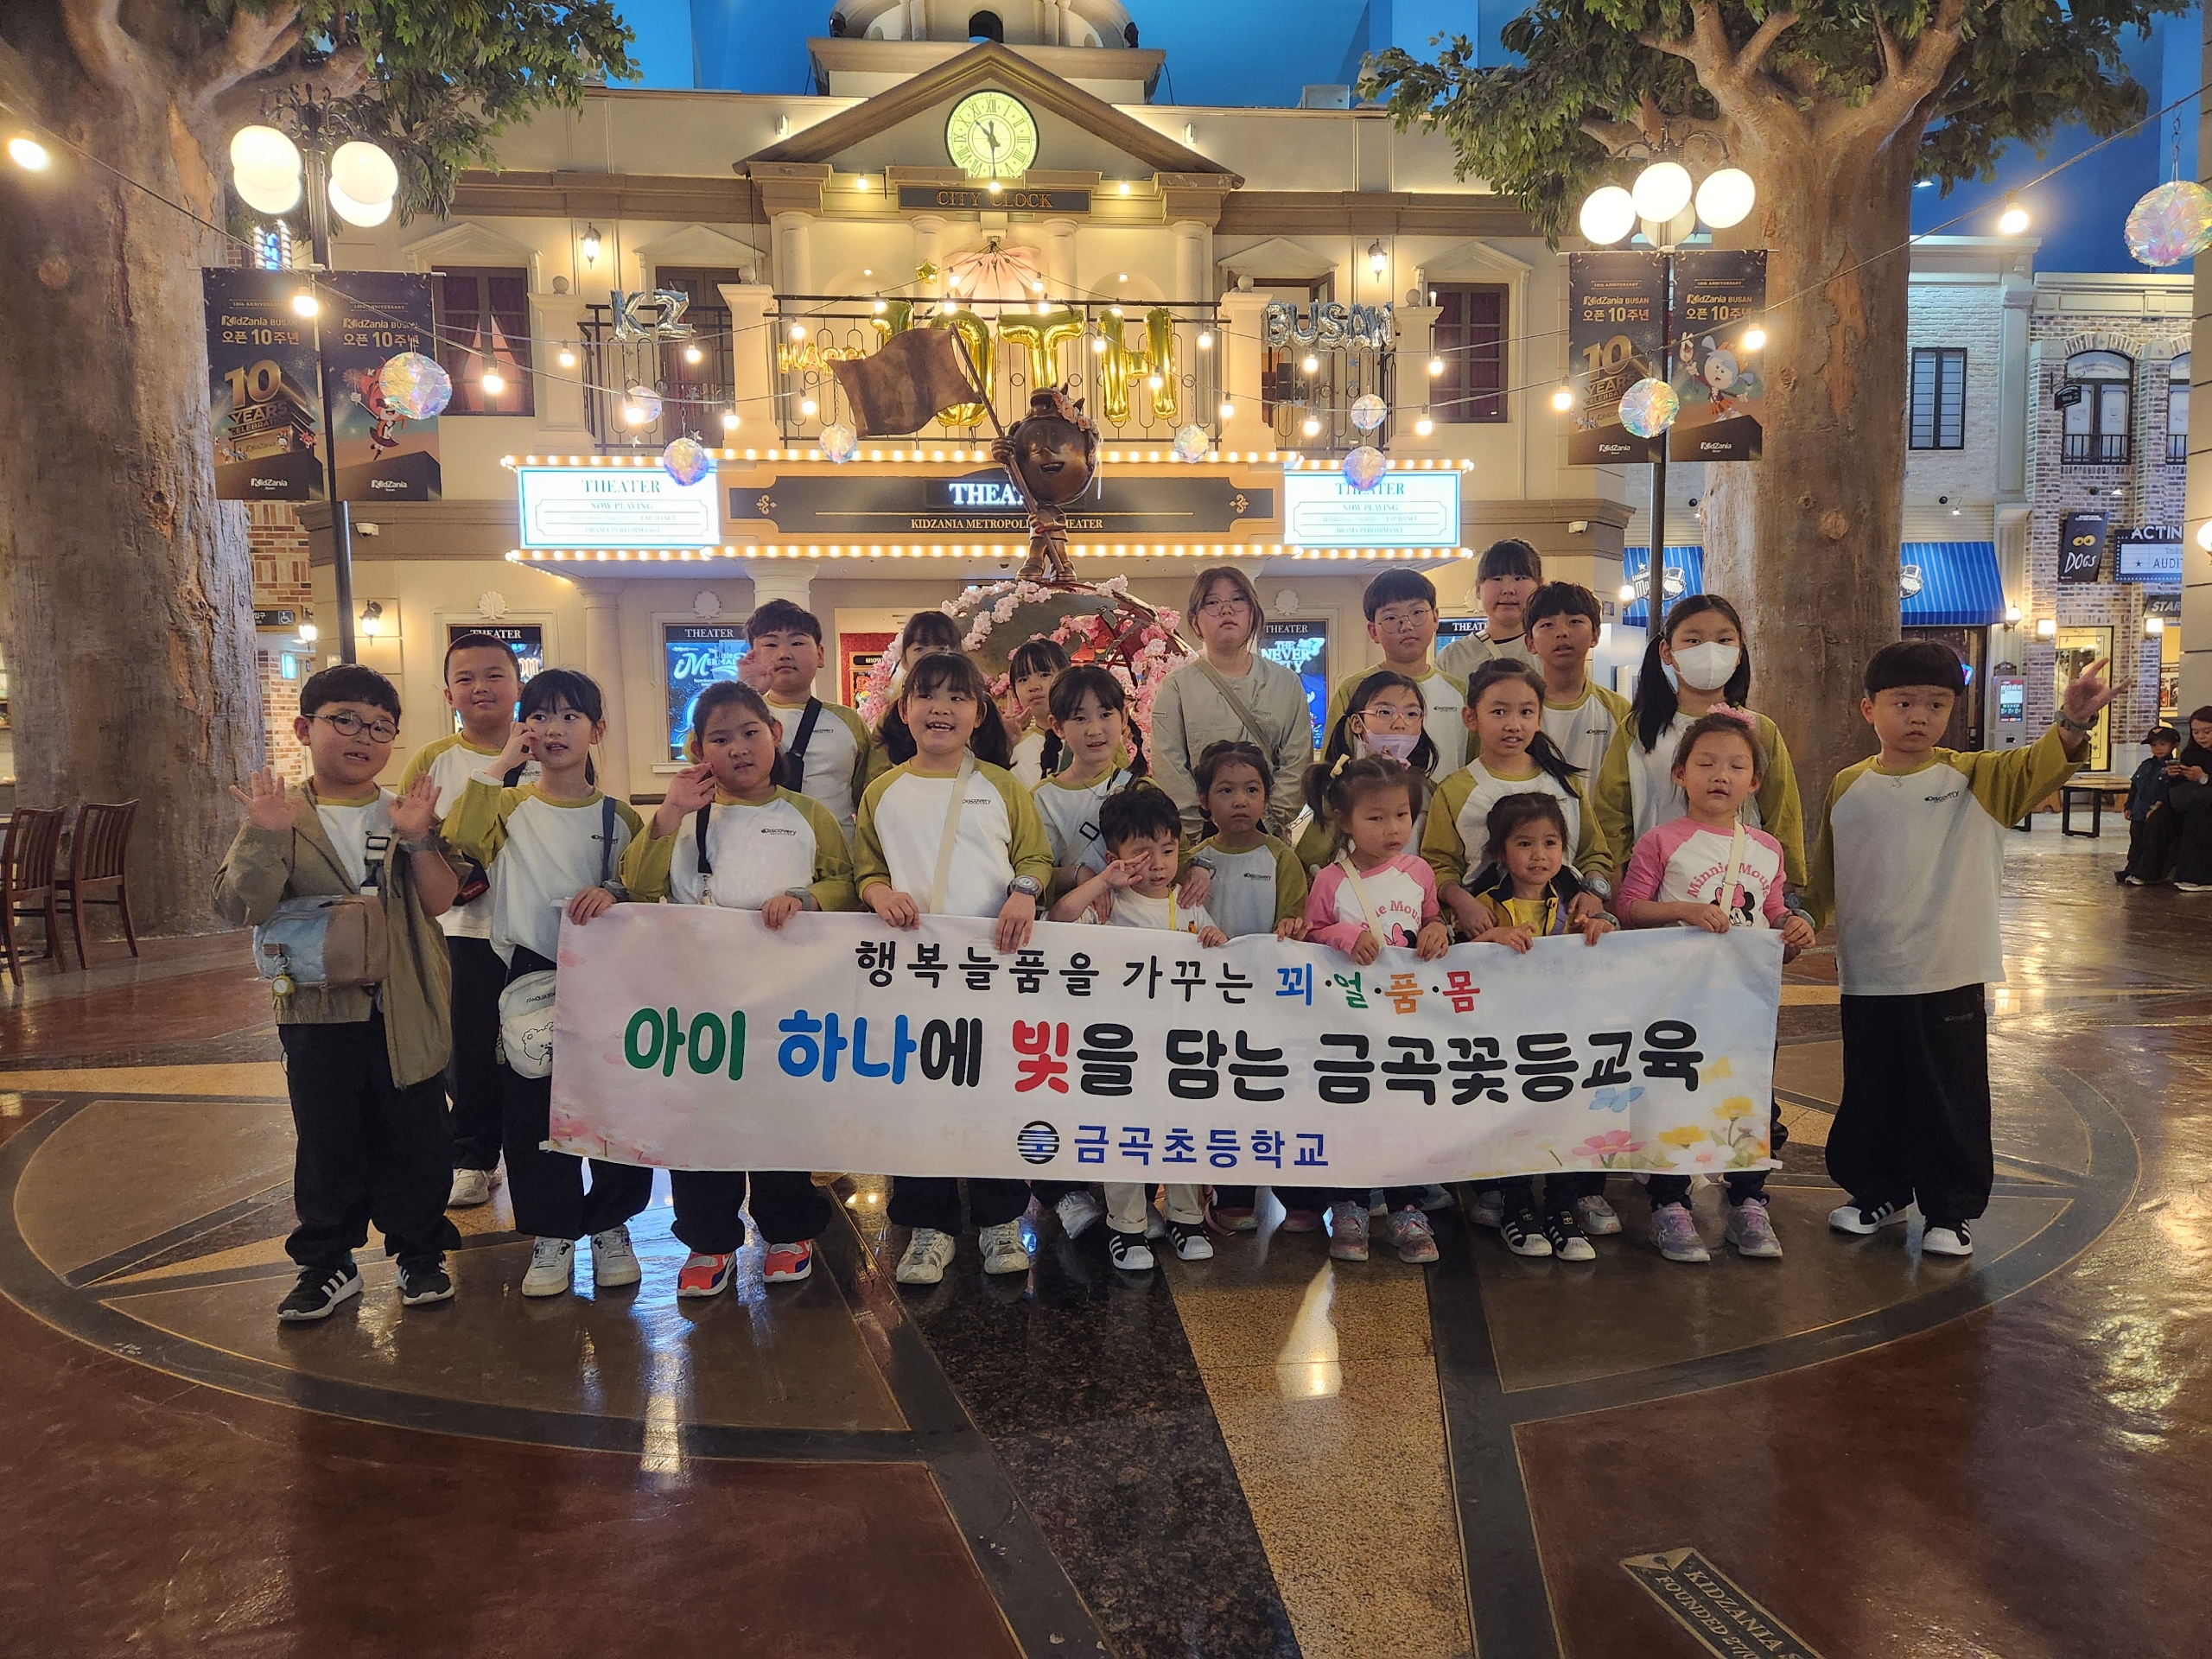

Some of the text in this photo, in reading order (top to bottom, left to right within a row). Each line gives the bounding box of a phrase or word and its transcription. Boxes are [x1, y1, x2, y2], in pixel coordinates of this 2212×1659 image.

[937, 191, 1052, 208] CITY CLOCK
[1583, 296, 1624, 306] KidZania
[1686, 294, 1726, 304] KidZania
[1583, 307, 1649, 322] 오픈 10주년
[1686, 308, 1708, 320] 오픈
[221, 315, 268, 326] KidZania
[343, 318, 389, 328] KidZania
[1261, 301, 1393, 347] BUSAN
[222, 329, 299, 345] 오픈 10주년
[343, 334, 368, 346] 오픈
[1583, 335, 1631, 381] 10
[225, 359, 281, 409] 10
[1585, 373, 1636, 394] YEARS
[231, 401, 288, 424] YEARS
[1700, 442, 1732, 450] KidZania
[251, 478, 288, 487] KidZania
[372, 480, 408, 489] KidZania
[582, 480, 660, 493] THEATER
[911, 519, 963, 529] KIDZANIA
[2063, 552, 2097, 574] DOGS
[2153, 558, 2183, 569] AUDI
[1452, 622, 1488, 632] THEAT
[684, 629, 734, 638] THEATER
[1274, 641, 1296, 650] THE
[1262, 649, 1313, 661] NEVER
[855, 940, 1099, 997] 행복늘품을
[1123, 955, 1254, 1004] 가꾸는
[624, 1007, 1704, 1106] 아이 하나에 빛을 담는 금곡꽃등교육
[1074, 1125, 1329, 1169] 금곡초등학교
[1655, 1574, 1729, 1636] FOUNDED
[1684, 1569, 1783, 1652] KIDZANIA
